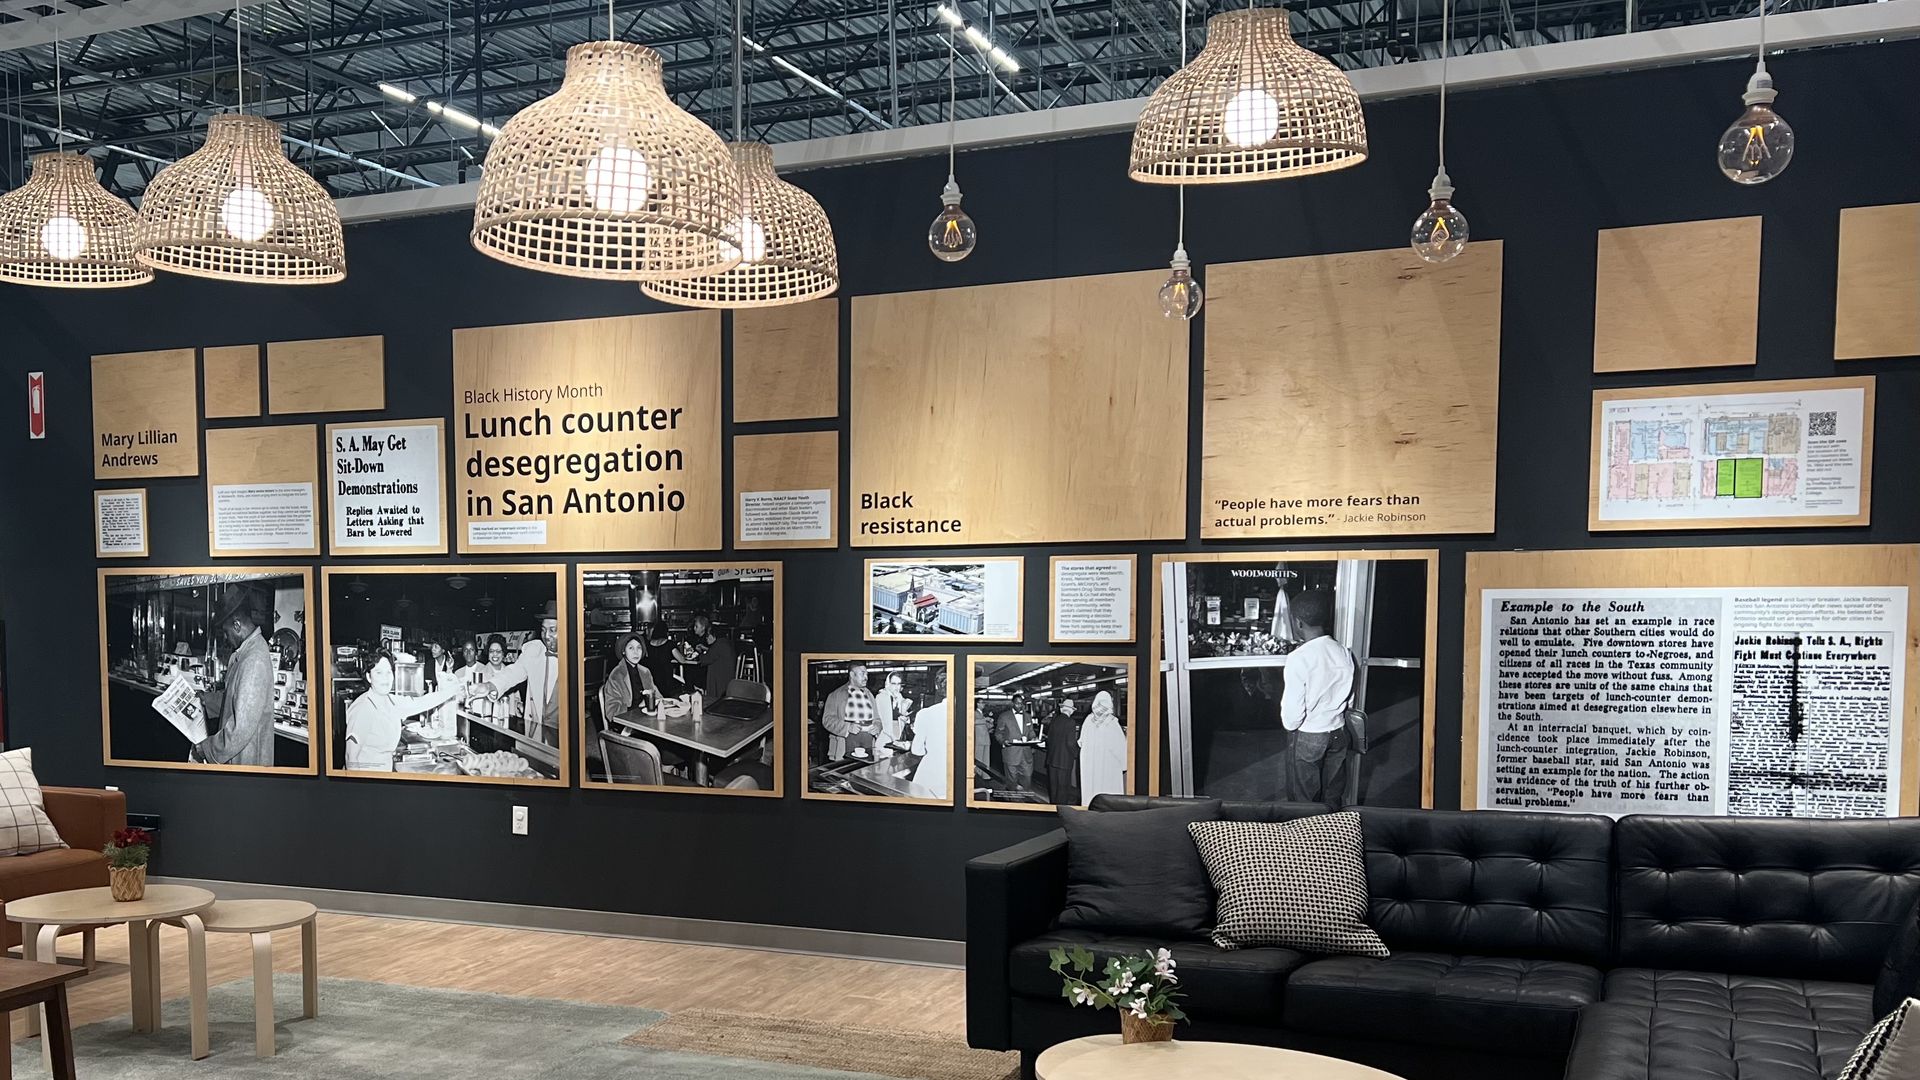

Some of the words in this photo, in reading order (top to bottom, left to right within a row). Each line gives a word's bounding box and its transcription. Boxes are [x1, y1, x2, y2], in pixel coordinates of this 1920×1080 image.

[465, 389, 499, 404] Black
[504, 388, 552, 404] History
[558, 383, 602, 398] Month
[464, 408, 550, 438] Lunch
[562, 406, 682, 434] counter
[102, 433, 134, 449] Mary
[138, 430, 177, 444] Lillian
[336, 437, 345, 452] S.
[349, 436, 359, 452] A.
[362, 436, 384, 456] May
[388, 434, 406, 450] Get
[102, 452, 158, 467] Andrews
[338, 458, 384, 474] Sit-Down
[467, 444, 682, 485] desegregation
[338, 479, 418, 495] Demonstrations
[468, 490, 492, 516] in
[502, 490, 552, 515] San
[563, 484, 684, 516] Antonio
[862, 492, 913, 509] Black
[1215, 499, 1265, 512] “People
[1270, 498, 1302, 508] have
[1308, 498, 1342, 507] more
[1347, 496, 1382, 506] fears
[1387, 494, 1419, 505] than
[346, 506, 372, 518] Replies
[377, 505, 408, 514] Awaited
[347, 517, 373, 526] Letters
[378, 517, 404, 527] Asking
[408, 516, 424, 525] that
[862, 518, 961, 534] resistance
[1215, 516, 1255, 527] actual
[1261, 514, 1334, 528] problems.”
[1344, 514, 1374, 522] Jackie
[1378, 513, 1426, 521] Robinson
[347, 528, 364, 537] Bars
[368, 528, 376, 537] be
[380, 527, 412, 536] Lowered
[176, 576, 195, 586] SAVES
[196, 576, 208, 584] YOU
[1500, 601, 1553, 615] Example
[1562, 601, 1574, 612] to
[1582, 602, 1600, 612] the
[1608, 602, 1644, 612] South
[1510, 617, 1527, 625] San
[1532, 617, 1569, 625] Antonio
[1574, 617, 1590, 625] has
[1596, 617, 1608, 625] set
[1632, 617, 1672, 628] example
[1679, 617, 1687, 625] in
[1500, 627, 1538, 636] relations
[1542, 627, 1562, 636] that
[1565, 627, 1590, 636] other
[1594, 628, 1636, 636] Southern
[1640, 628, 1664, 636] cities
[1670, 628, 1698, 636] would
[1702, 628, 1714, 637] do
[1499, 638, 1518, 646] well
[1522, 638, 1530, 646] to
[1534, 638, 1574, 647] emulate.
[1583, 638, 1603, 647] Five
[1607, 638, 1654, 647] downtown
[1659, 639, 1686, 647] stores
[1691, 639, 1713, 648] have
[1734, 636, 1761, 645] Jackie
[1807, 636, 1825, 645] Tells
[1828, 637, 1836, 645] S.
[1840, 637, 1851, 647] A.,
[1855, 636, 1883, 647] Rights
[1734, 651, 1756, 661] Fight
[1826, 651, 1876, 661] Everywhere
[1499, 659, 1532, 668] citizens
[1536, 660, 1546, 668] of
[1550, 660, 1562, 668] all
[1595, 660, 1604, 668] in
[1608, 660, 1622, 669] the
[1628, 660, 1655, 669] Texas
[1660, 661, 1713, 672] community
[1499, 669, 1519, 678] have
[1522, 670, 1562, 681] accepted
[1566, 670, 1581, 679] the
[1611, 671, 1647, 680] without
[1651, 672, 1672, 680] fuss.
[1679, 672, 1712, 683] Among
[1498, 691, 1518, 699] have
[1524, 691, 1546, 700] been
[1552, 692, 1584, 703] targets
[1590, 692, 1600, 701] of
[1606, 693, 1671, 702] lunch-counter
[1678, 694, 1712, 703] demon-
[1498, 701, 1536, 710] strations
[1539, 702, 1567, 711] aimed
[1571, 703, 1580, 711] at
[1584, 703, 1646, 715] desegregation
[1651, 704, 1697, 714] elsewhere
[1702, 706, 1711, 714] in
[1508, 722, 1518, 731] At
[1539, 723, 1586, 733] interracial
[1592, 725, 1631, 736] banquet,
[1637, 726, 1665, 735] which
[1672, 727, 1682, 738] by
[1689, 727, 1710, 736] coin-
[1496, 743, 1558, 754] lunch-counter
[1566, 746, 1617, 758] integration,
[1626, 747, 1656, 756] Jackie
[1664, 748, 1710, 759] Robinson,
[1496, 754, 1527, 763] former
[1532, 755, 1570, 765] baseball
[1575, 756, 1595, 767] star,
[1601, 757, 1619, 766] said
[1625, 758, 1642, 767] San
[1648, 759, 1686, 768] Antonio
[1496, 765, 1526, 776] setting
[1542, 766, 1581, 778] example
[1584, 768, 1598, 776] for
[1600, 768, 1614, 777] the
[1618, 769, 1650, 778] nation.
[1659, 770, 1677, 779] The
[1681, 771, 1709, 780] action
[1496, 785, 1538, 797] servation,
[1591, 789, 1612, 798] have
[1655, 792, 1678, 801] fears
[1688, 793, 1708, 802] than
